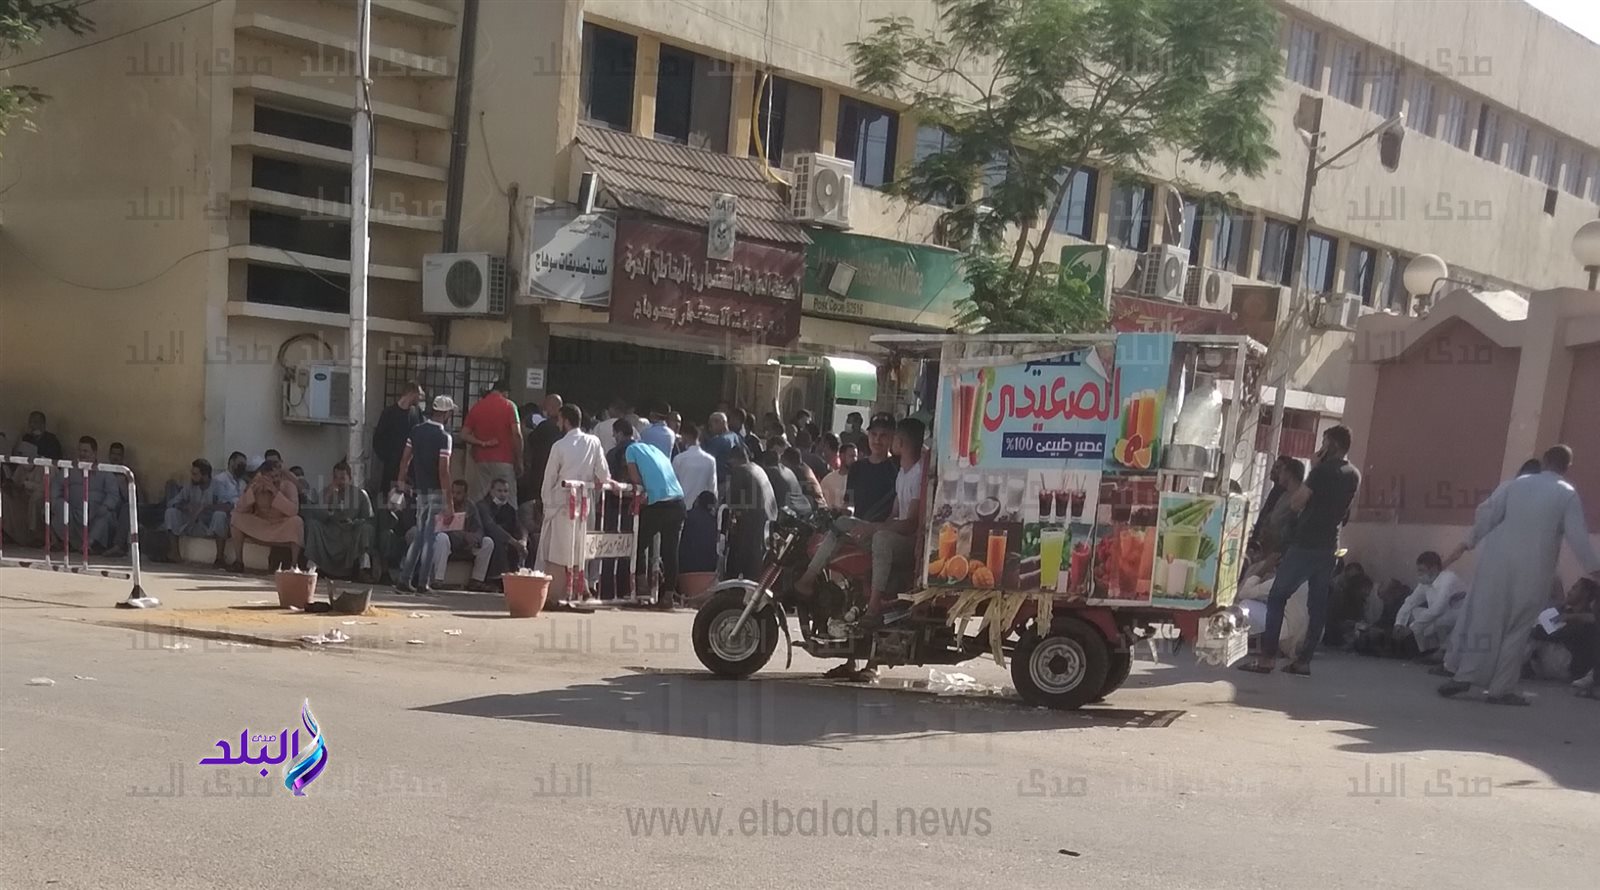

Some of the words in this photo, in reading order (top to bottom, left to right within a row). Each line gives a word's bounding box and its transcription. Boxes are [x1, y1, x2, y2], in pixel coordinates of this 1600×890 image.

[714, 197, 736, 213] GAFI
[535, 250, 559, 273] سوهاج
[558, 251, 591, 278] تصديقات
[591, 257, 607, 280] مكتب
[625, 243, 651, 280] الحرة
[633, 294, 677, 325] بسوهاج
[1074, 440, 1103, 457] عصير
